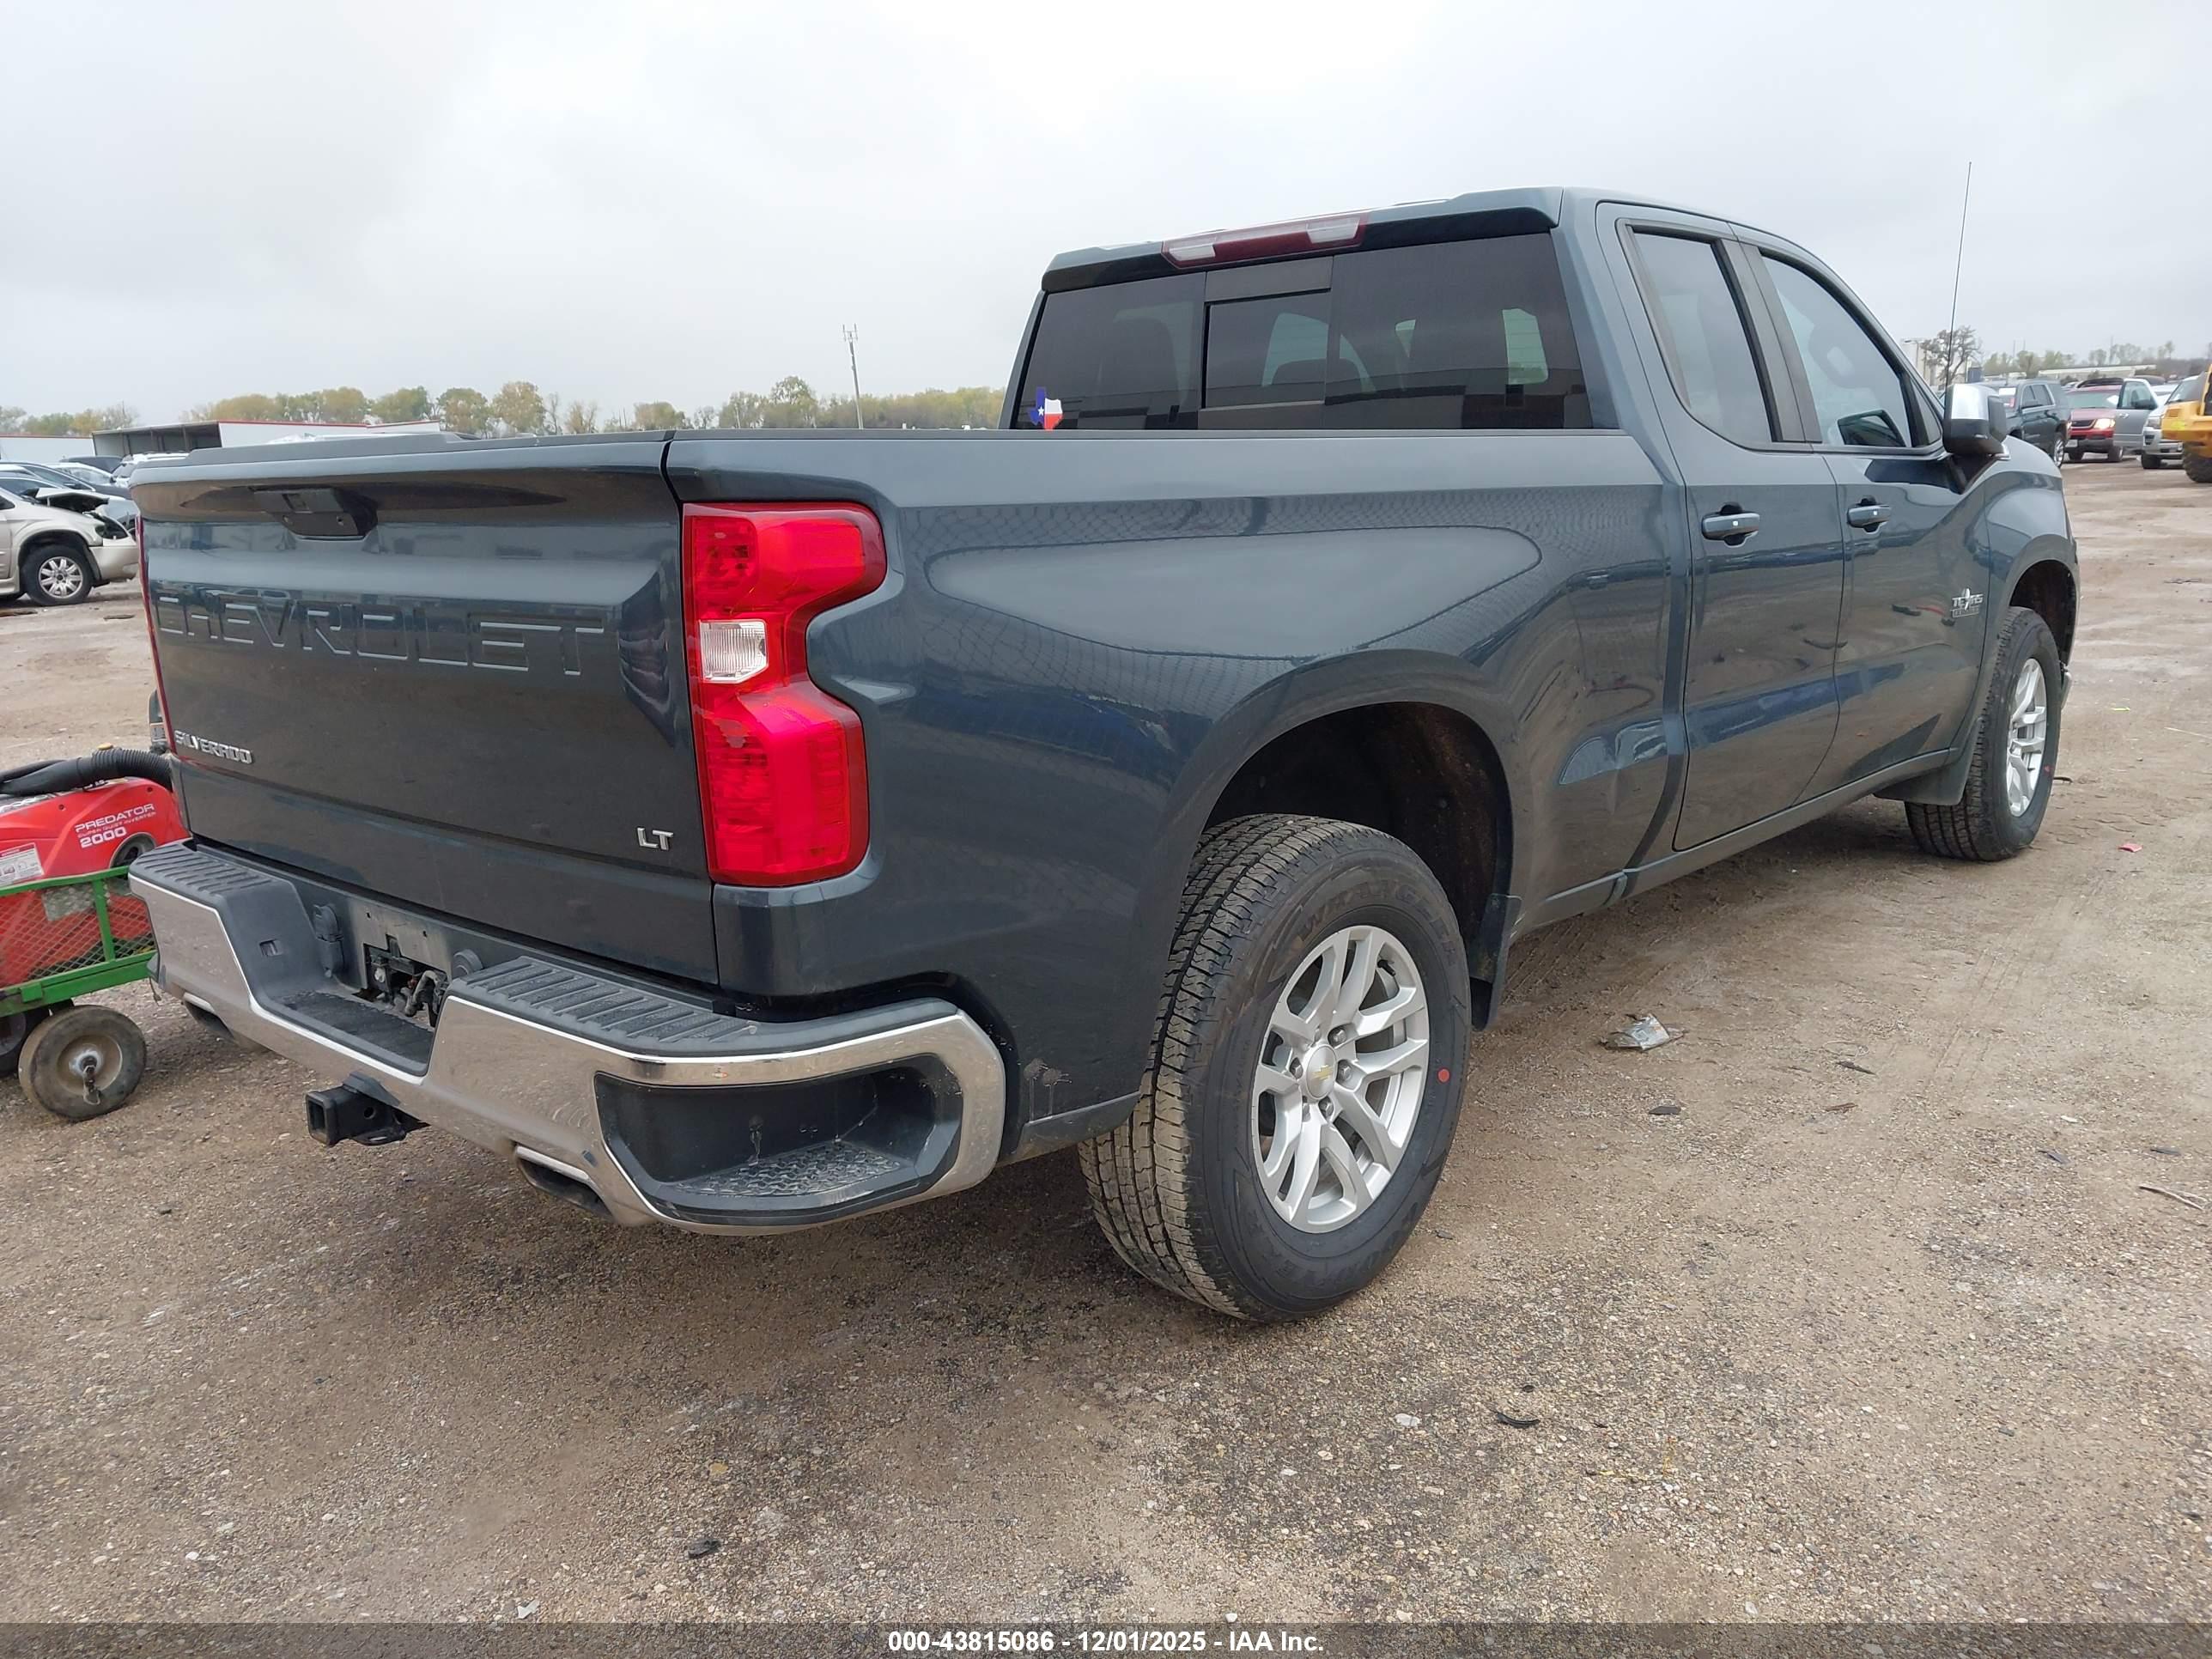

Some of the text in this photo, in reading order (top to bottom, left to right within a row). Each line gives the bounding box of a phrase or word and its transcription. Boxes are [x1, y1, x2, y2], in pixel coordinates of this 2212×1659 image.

[157, 593, 604, 676] CHEVROLET
[174, 730, 252, 764] SILVERADO
[75, 803, 155, 832] PREDATOR
[80, 826, 127, 848] 2000
[637, 827, 674, 850] LT
